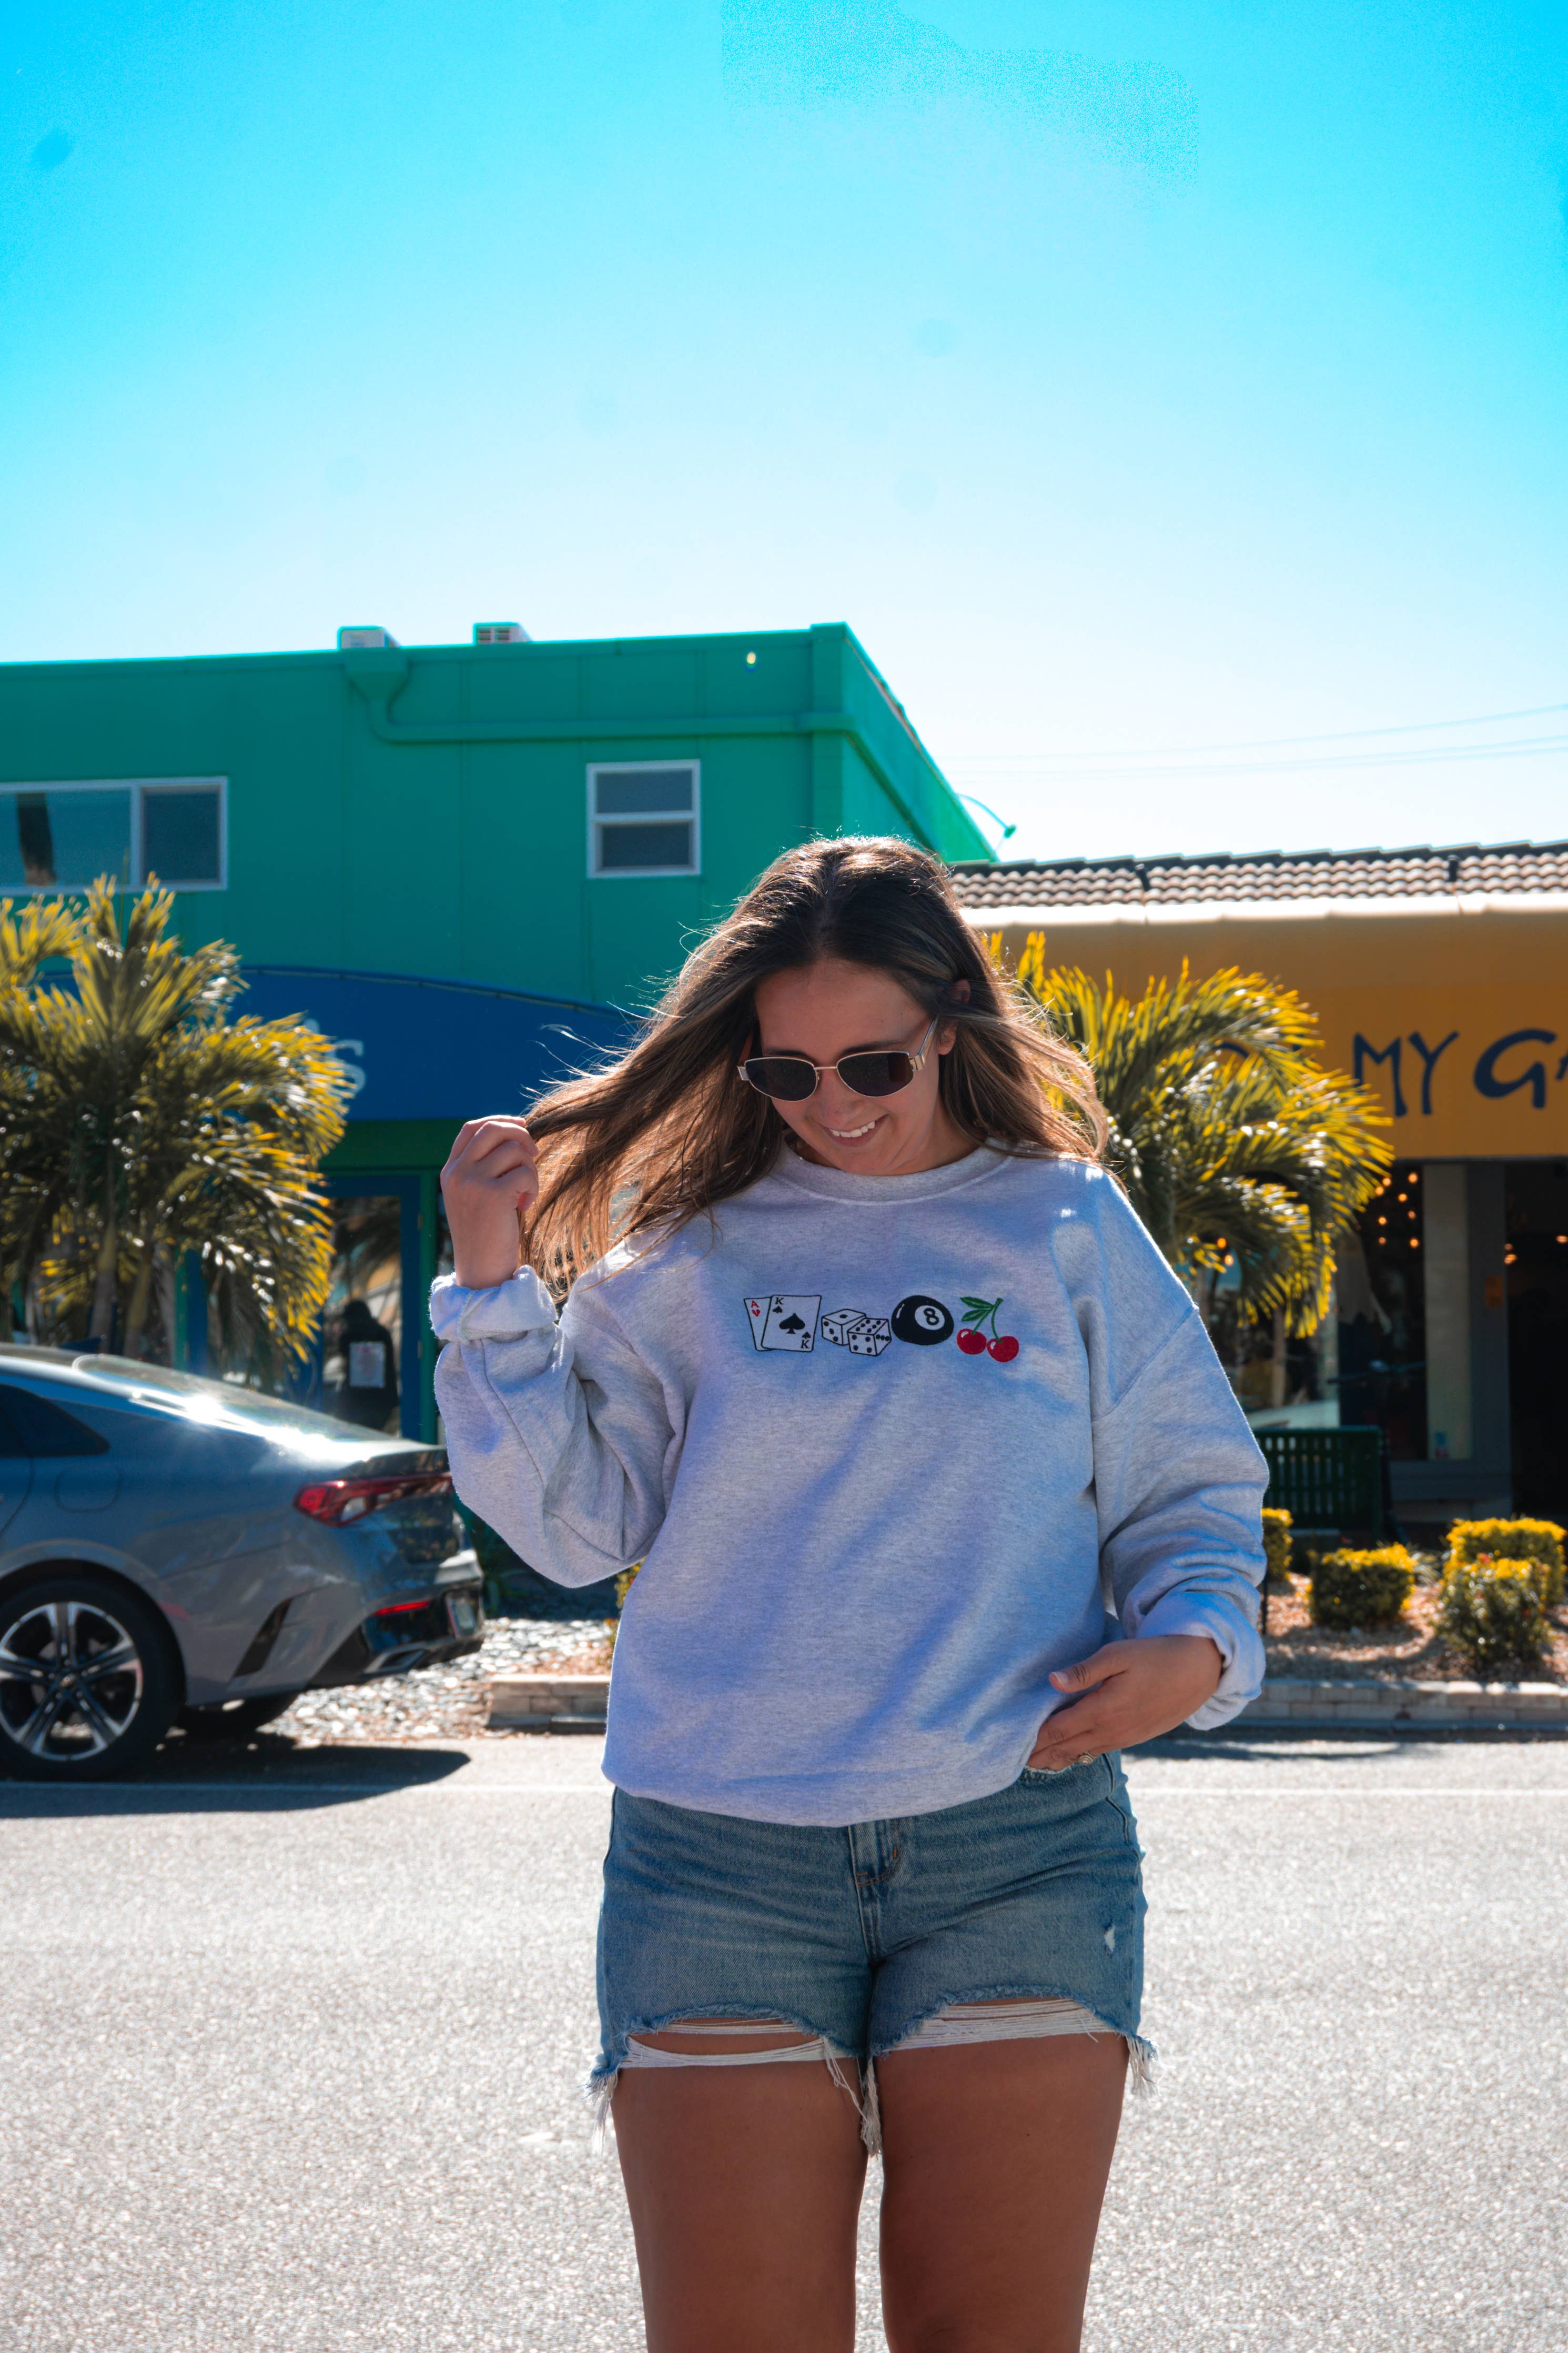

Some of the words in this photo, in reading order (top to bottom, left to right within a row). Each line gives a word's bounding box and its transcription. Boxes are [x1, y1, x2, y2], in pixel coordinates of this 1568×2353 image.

[1353, 1031, 1460, 1117] MY
[1474, 1028, 1568, 1109] G
[923, 1308, 939, 1325] 8
[801, 1340, 810, 1349] K
